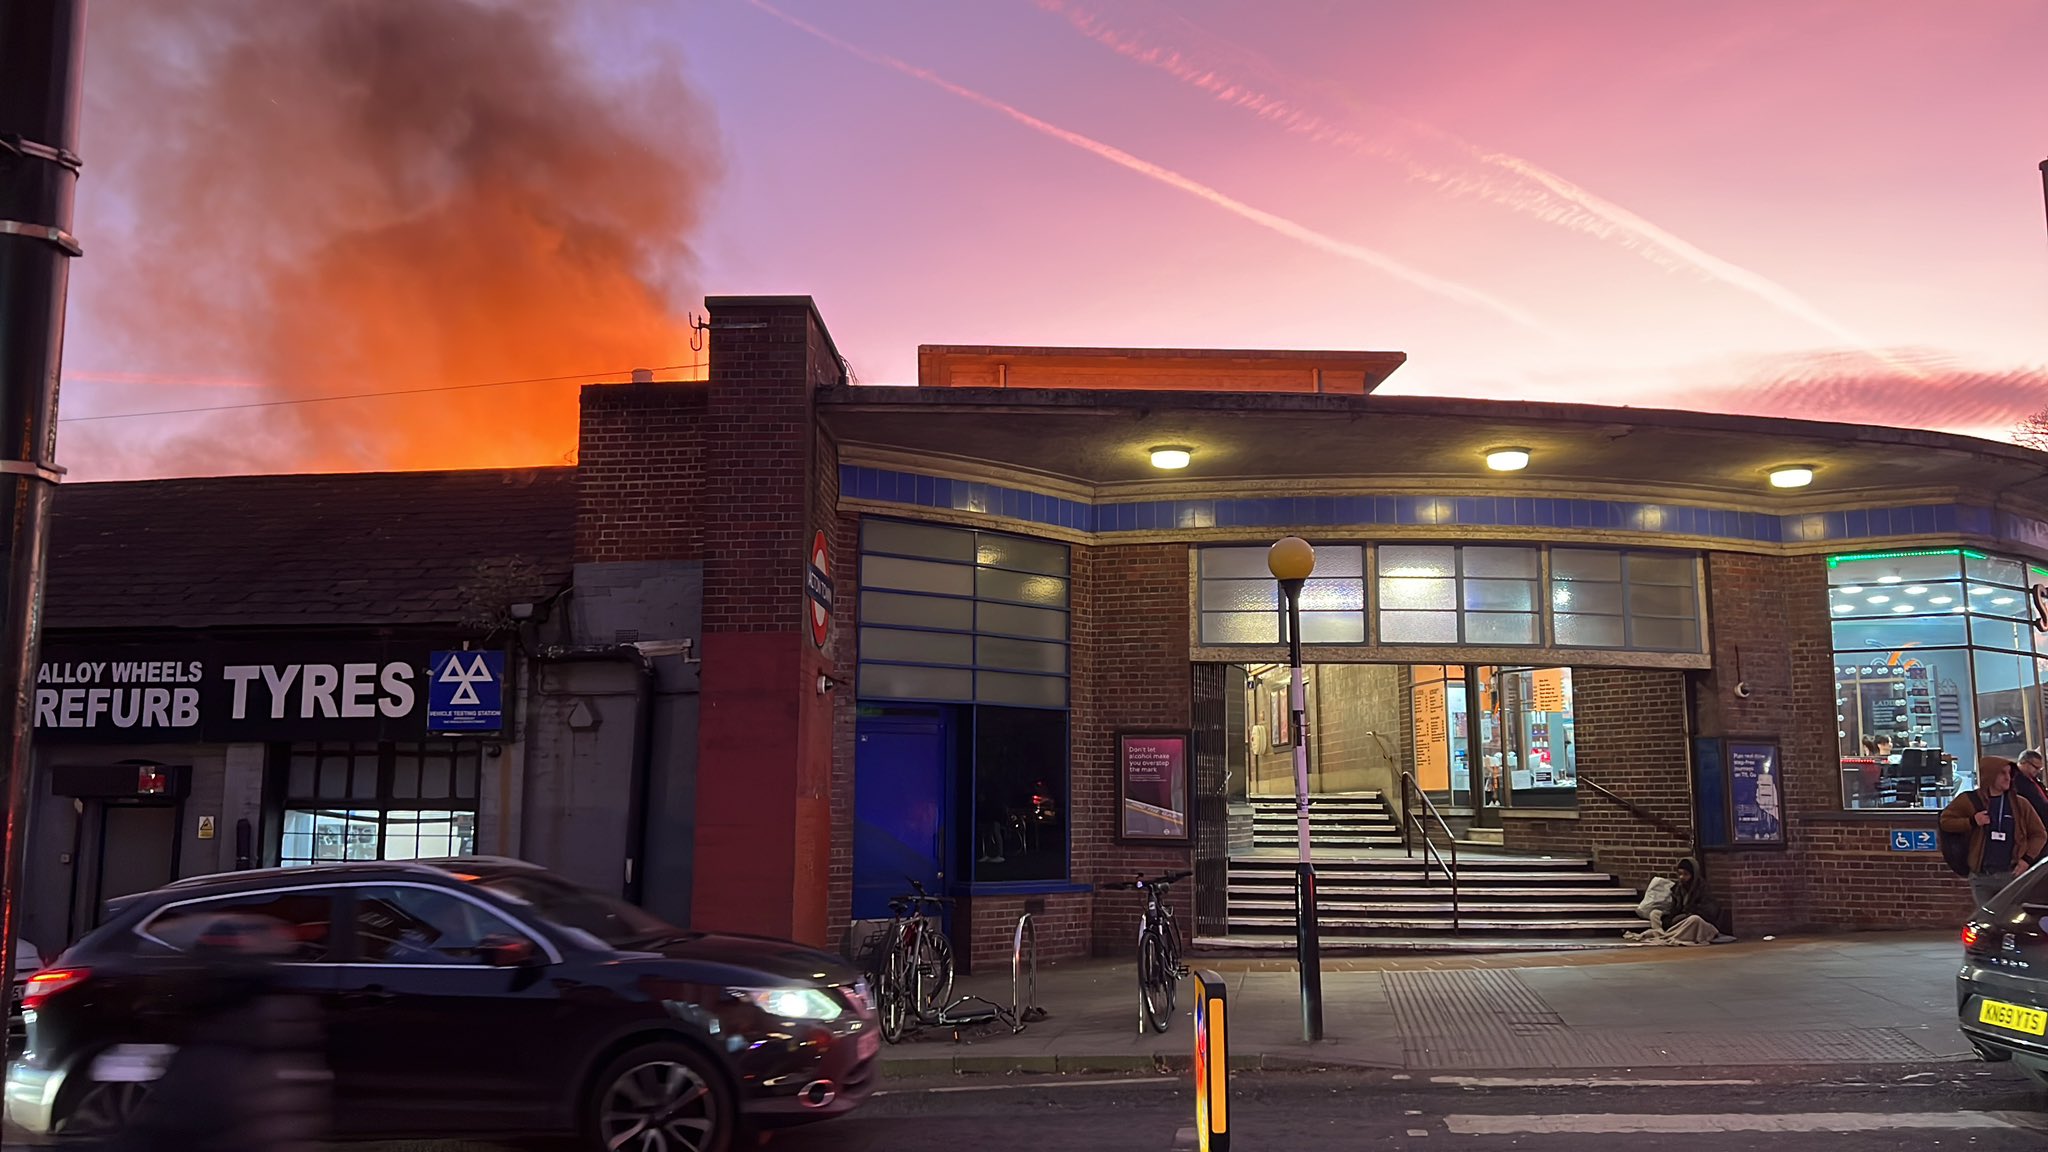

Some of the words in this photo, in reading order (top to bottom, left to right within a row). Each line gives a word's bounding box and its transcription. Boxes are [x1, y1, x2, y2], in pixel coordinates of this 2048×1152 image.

[37, 662, 106, 683] ALLOY
[112, 661, 203, 683] WHEELS
[223, 661, 415, 719] TYRES
[34, 688, 199, 728] REFURB
[1984, 1004, 2013, 1025] KN69
[2015, 1008, 2040, 1031] YTS
